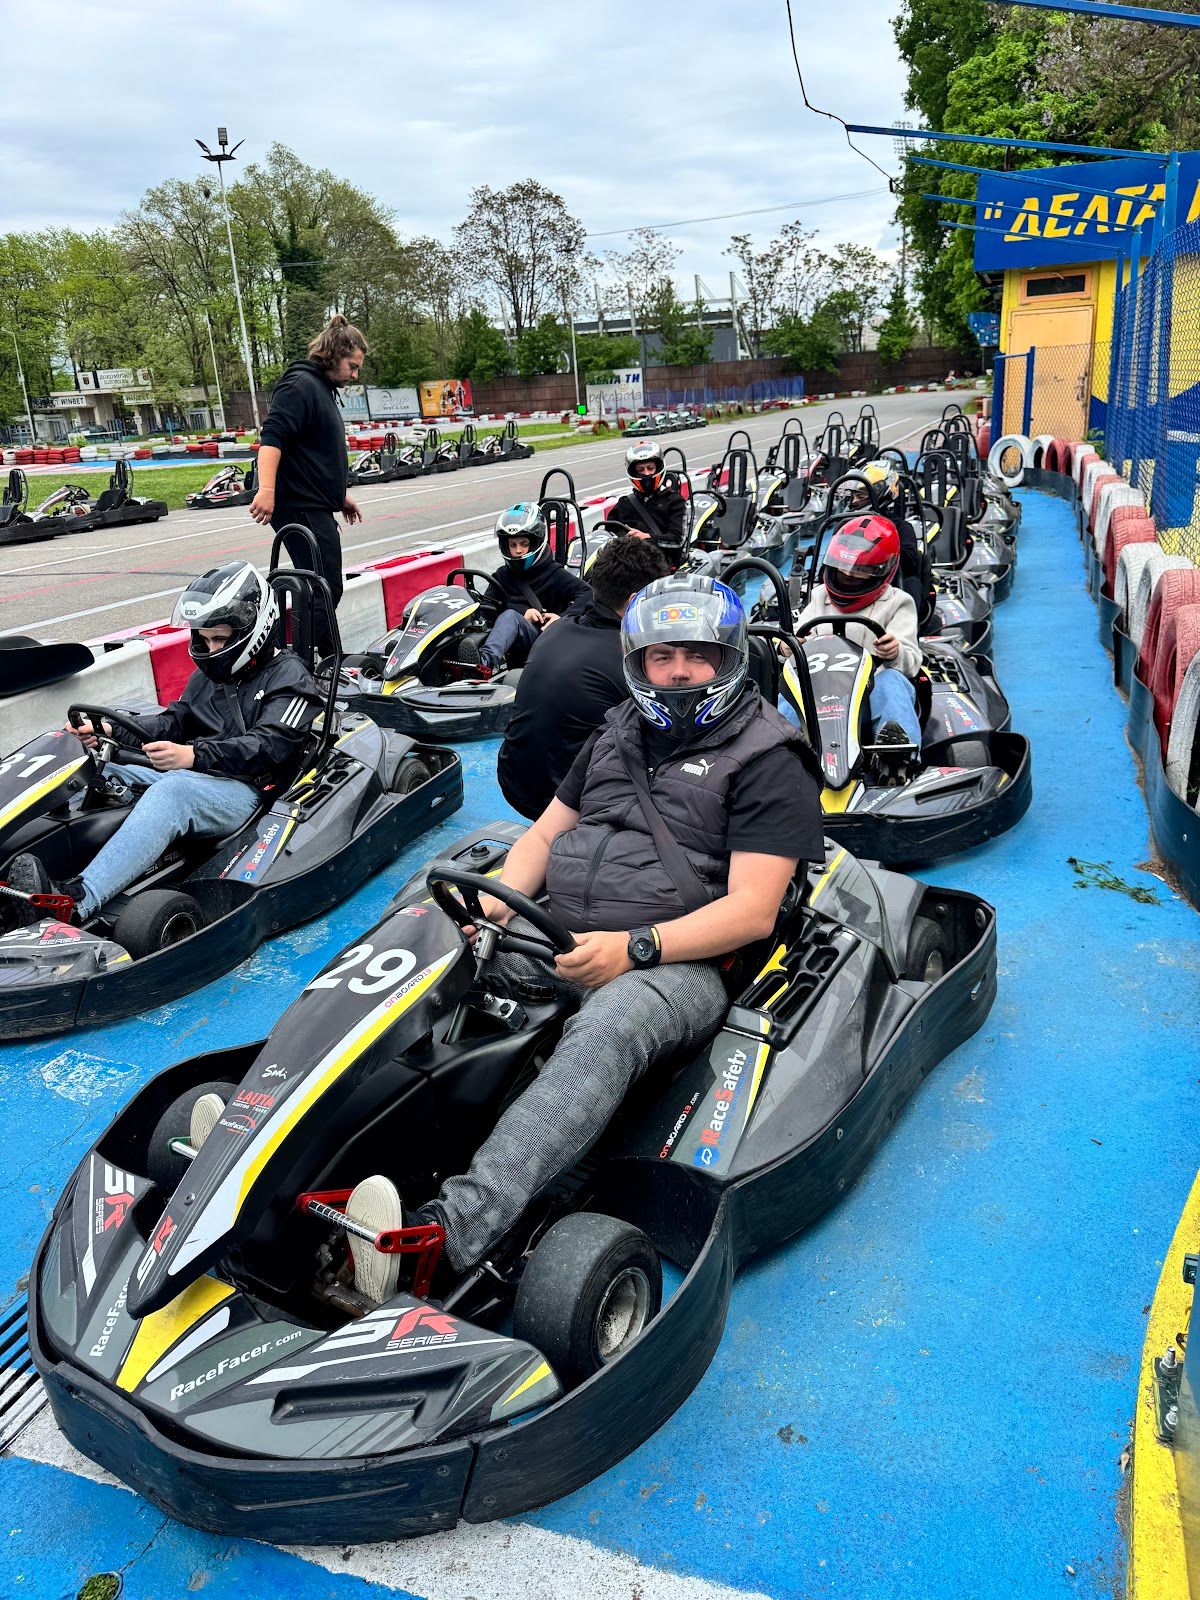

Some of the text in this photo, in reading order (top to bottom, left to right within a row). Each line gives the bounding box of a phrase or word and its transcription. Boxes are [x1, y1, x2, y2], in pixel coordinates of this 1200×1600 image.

[422, 592, 469, 610] 24
[660, 606, 697, 623] BOXS
[806, 652, 861, 675] 32
[680, 762, 705, 777] PUMA
[39, 936, 82, 946] SERIES
[305, 943, 417, 995] 29
[236, 1089, 275, 1107] LAUTA
[700, 1048, 747, 1146] RaceSafety
[95, 1197, 104, 1235] SERIES
[385, 1332, 459, 1350] SERIES
